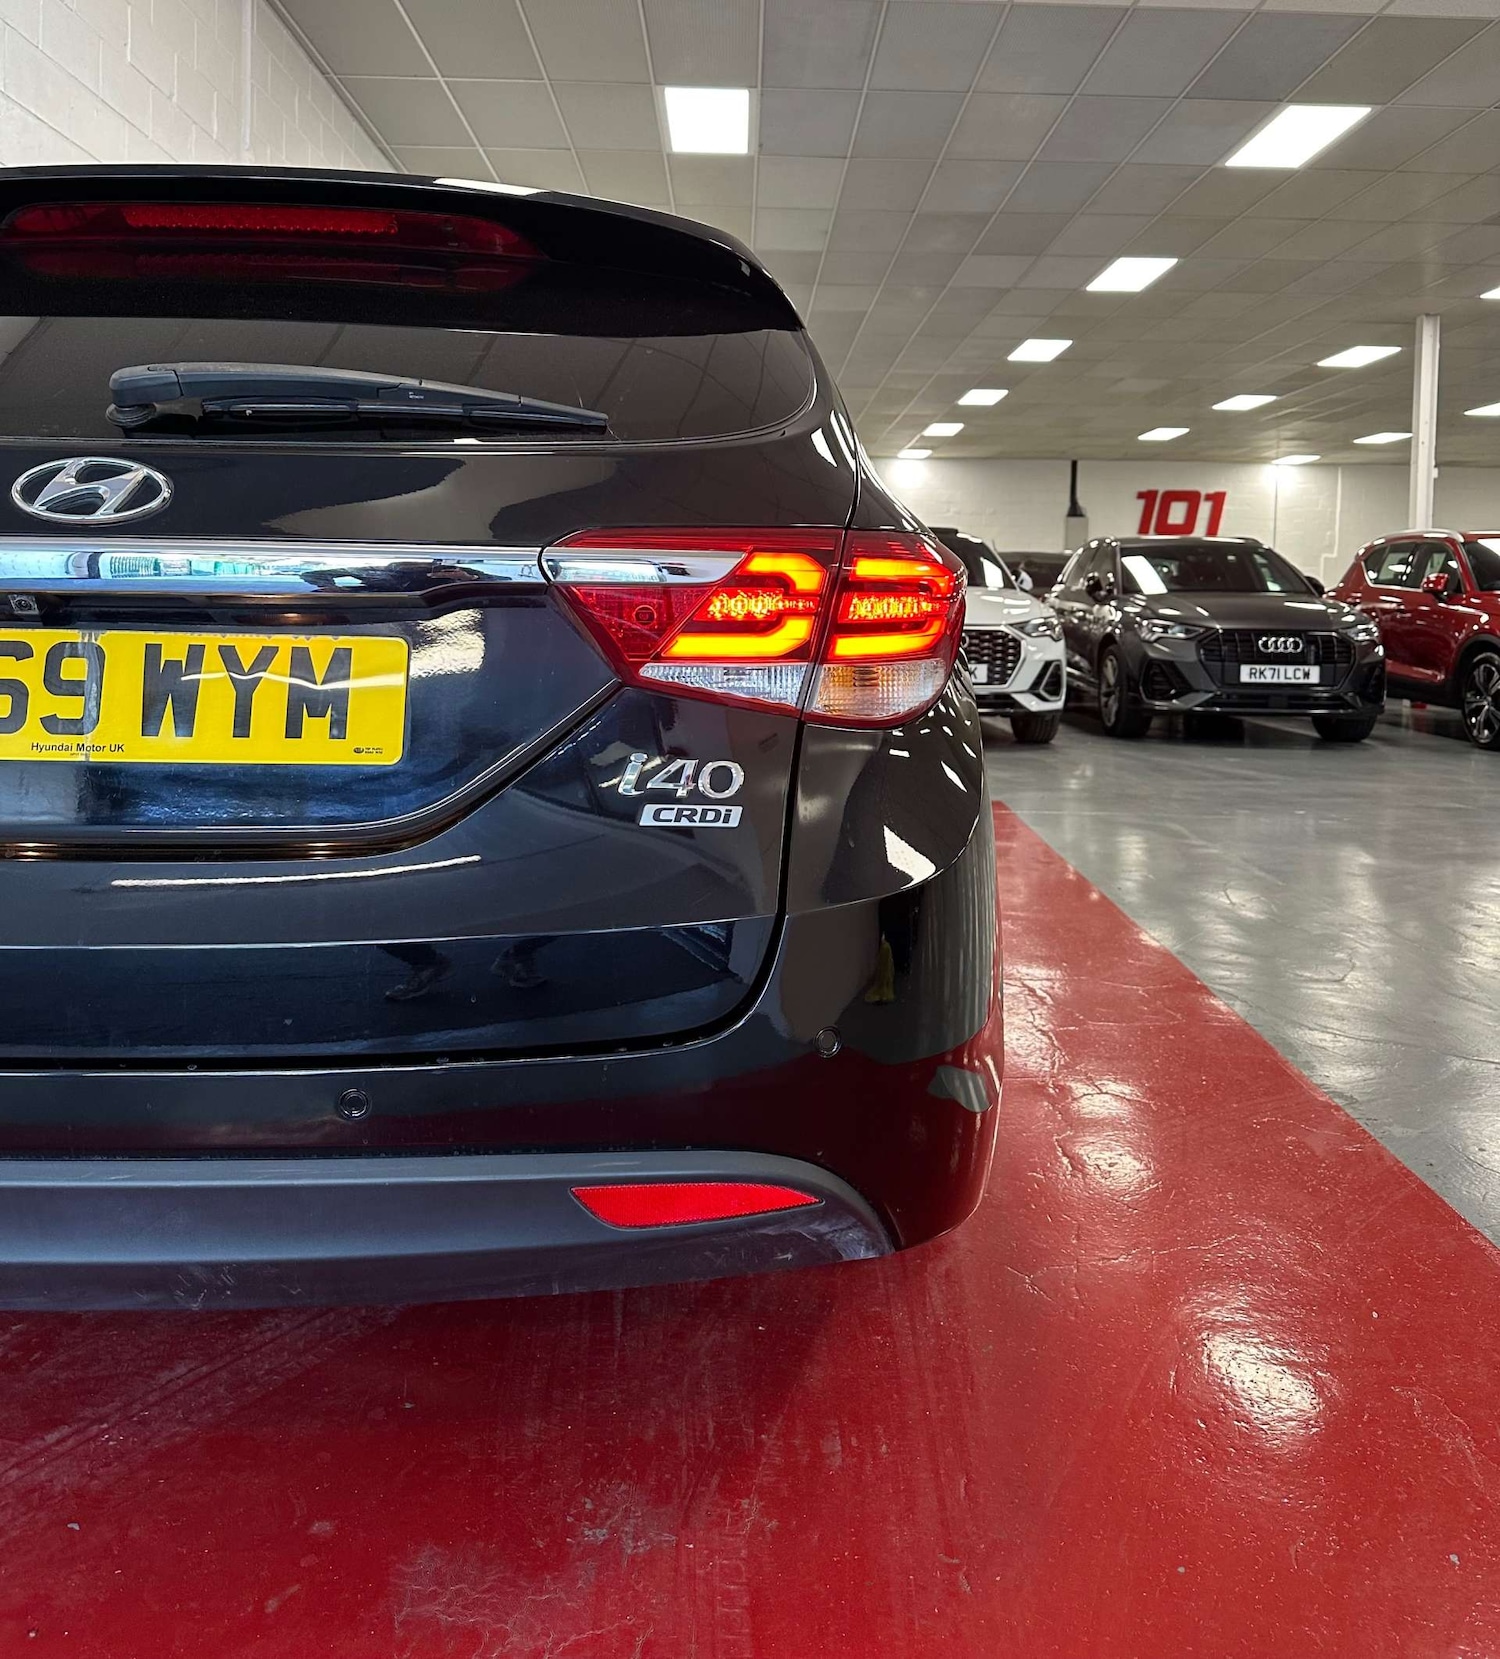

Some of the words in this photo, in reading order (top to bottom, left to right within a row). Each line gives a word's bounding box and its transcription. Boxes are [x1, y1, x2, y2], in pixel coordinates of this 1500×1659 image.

[1136, 489, 1227, 538] 101
[1248, 666, 1281, 681] RK71
[1284, 667, 1311, 681] LCW
[140, 643, 353, 740] WYM
[31, 742, 73, 753] Hyundai
[76, 743, 107, 752] Motor
[109, 743, 125, 753] UK
[617, 752, 745, 800] i40
[652, 806, 734, 825] CRDi
